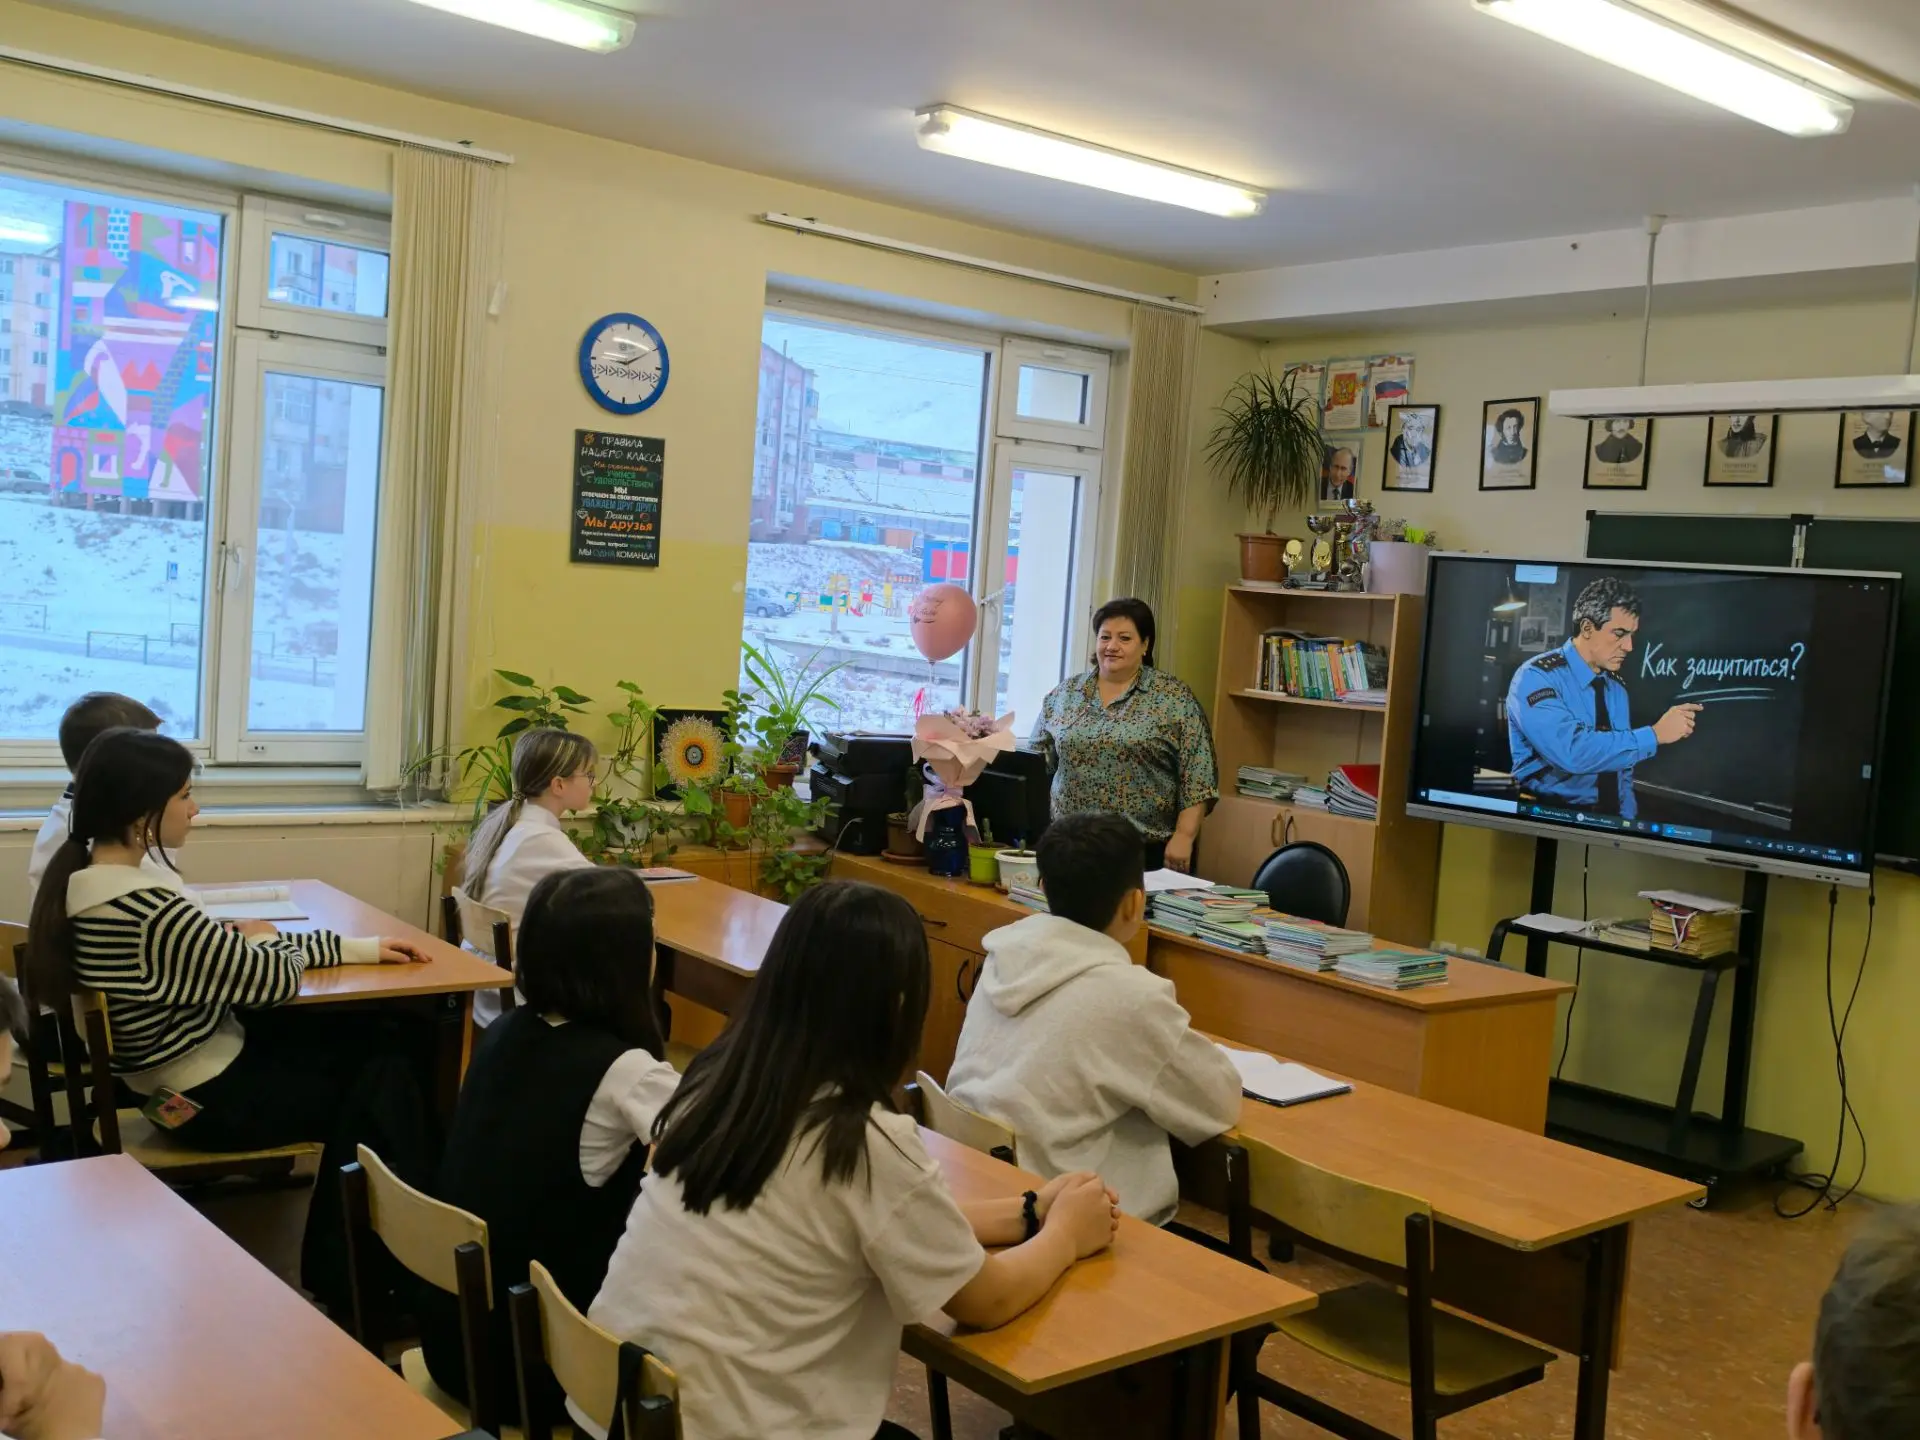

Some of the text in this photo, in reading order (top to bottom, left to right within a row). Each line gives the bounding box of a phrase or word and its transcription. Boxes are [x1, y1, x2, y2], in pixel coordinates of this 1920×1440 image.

[601, 436, 643, 448] ПРАВИЛА
[581, 447, 662, 463] НАШЕГО КЛАССА
[614, 486, 628, 494] МЫ
[583, 498, 657, 512] УВАЖАЕМ ДРУГ ДРУГА
[579, 548, 592, 556] МЫ
[616, 550, 656, 560] КОМАНДА!
[1641, 642, 1806, 690] Как защититься?
